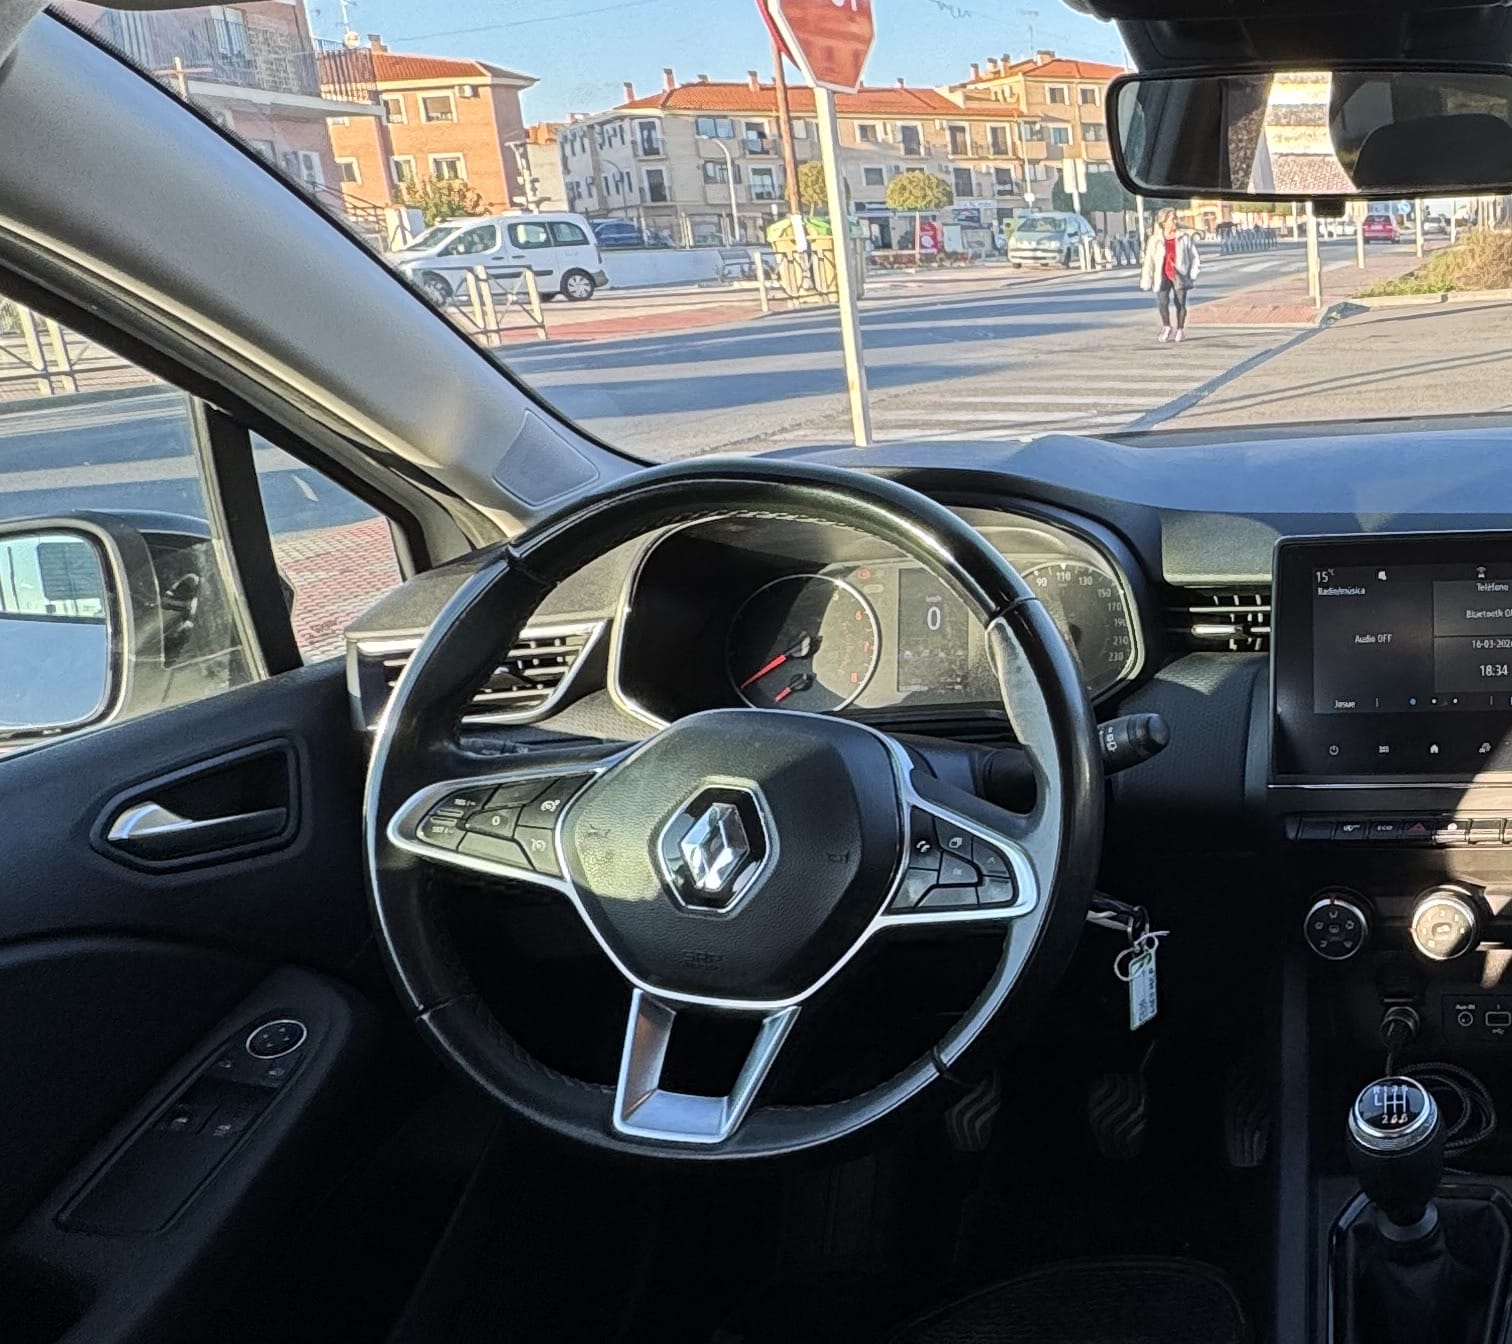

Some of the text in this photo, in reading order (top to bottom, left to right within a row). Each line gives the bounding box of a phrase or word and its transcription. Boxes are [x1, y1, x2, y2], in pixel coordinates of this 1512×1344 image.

[1035, 571, 1093, 587] 90 110 130
[1097, 588, 1112, 598] 150
[1108, 601, 1122, 611] 170
[926, 606, 942, 631] 0
[1113, 635, 1129, 645] 210
[1377, 634, 1393, 643] OFF
[1479, 664, 1509, 676] 18:34
[1381, 1114, 1389, 1124] 2
